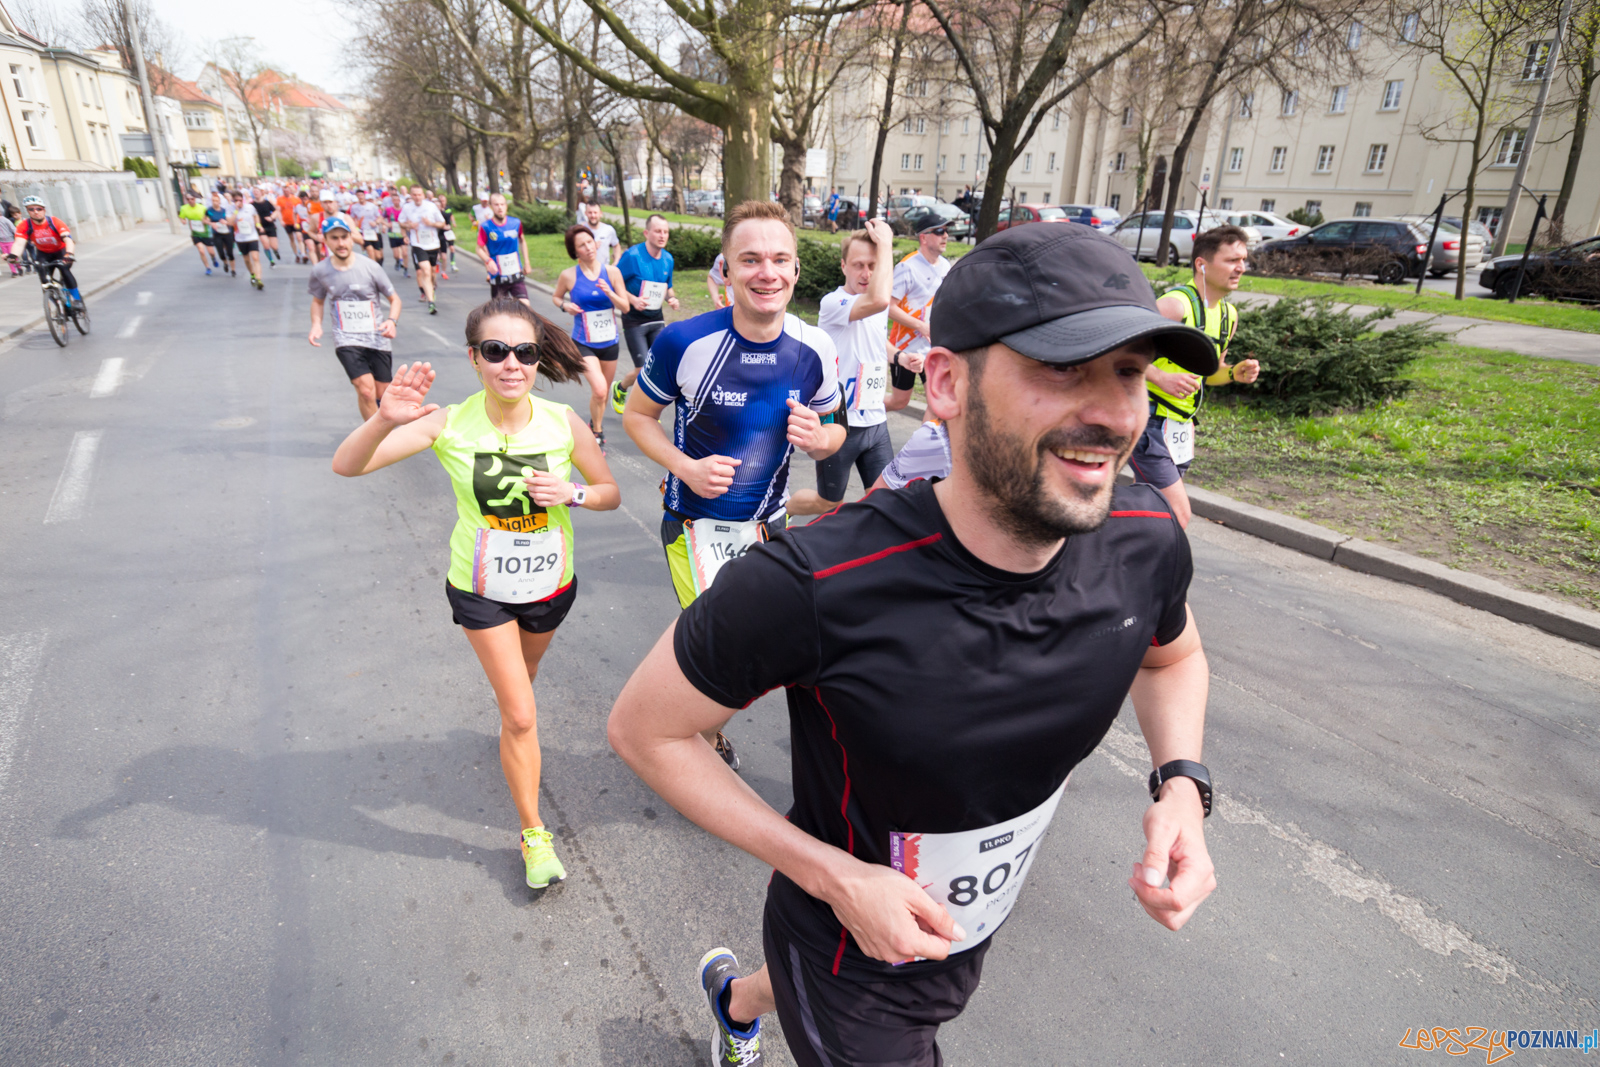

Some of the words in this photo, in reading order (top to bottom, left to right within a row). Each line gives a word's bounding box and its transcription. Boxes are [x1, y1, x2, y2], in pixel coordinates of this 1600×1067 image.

[342, 311, 370, 320] 12104
[593, 319, 612, 329] 9291
[494, 552, 558, 574] 10129
[994, 834, 1012, 846] PKO
[947, 829, 1045, 906] 807
